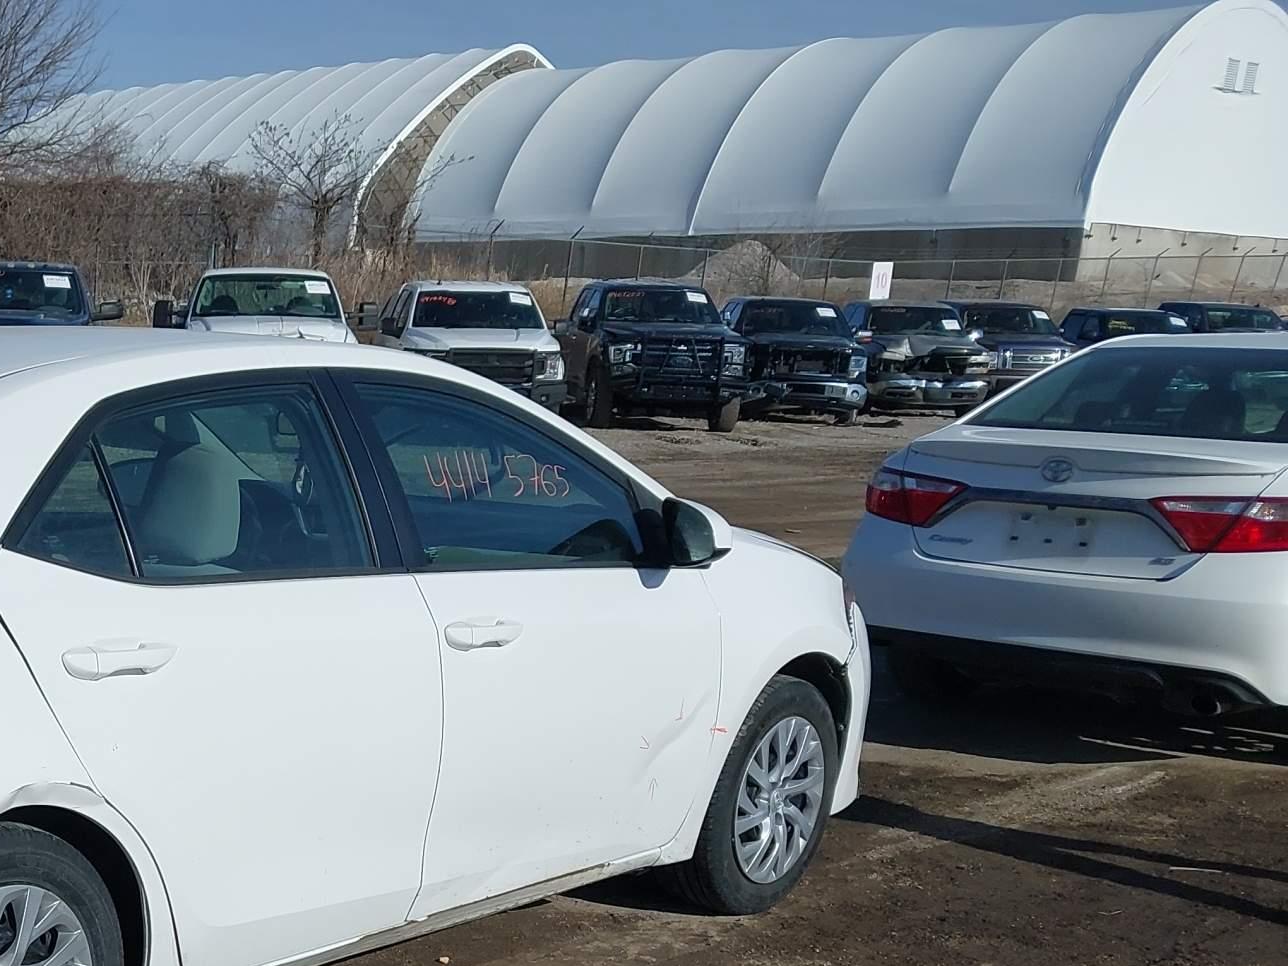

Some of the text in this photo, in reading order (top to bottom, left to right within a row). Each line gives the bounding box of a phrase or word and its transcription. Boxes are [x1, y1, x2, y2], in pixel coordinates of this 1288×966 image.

[876, 272, 888, 289] 10
[423, 449, 570, 503] 4414 5765
